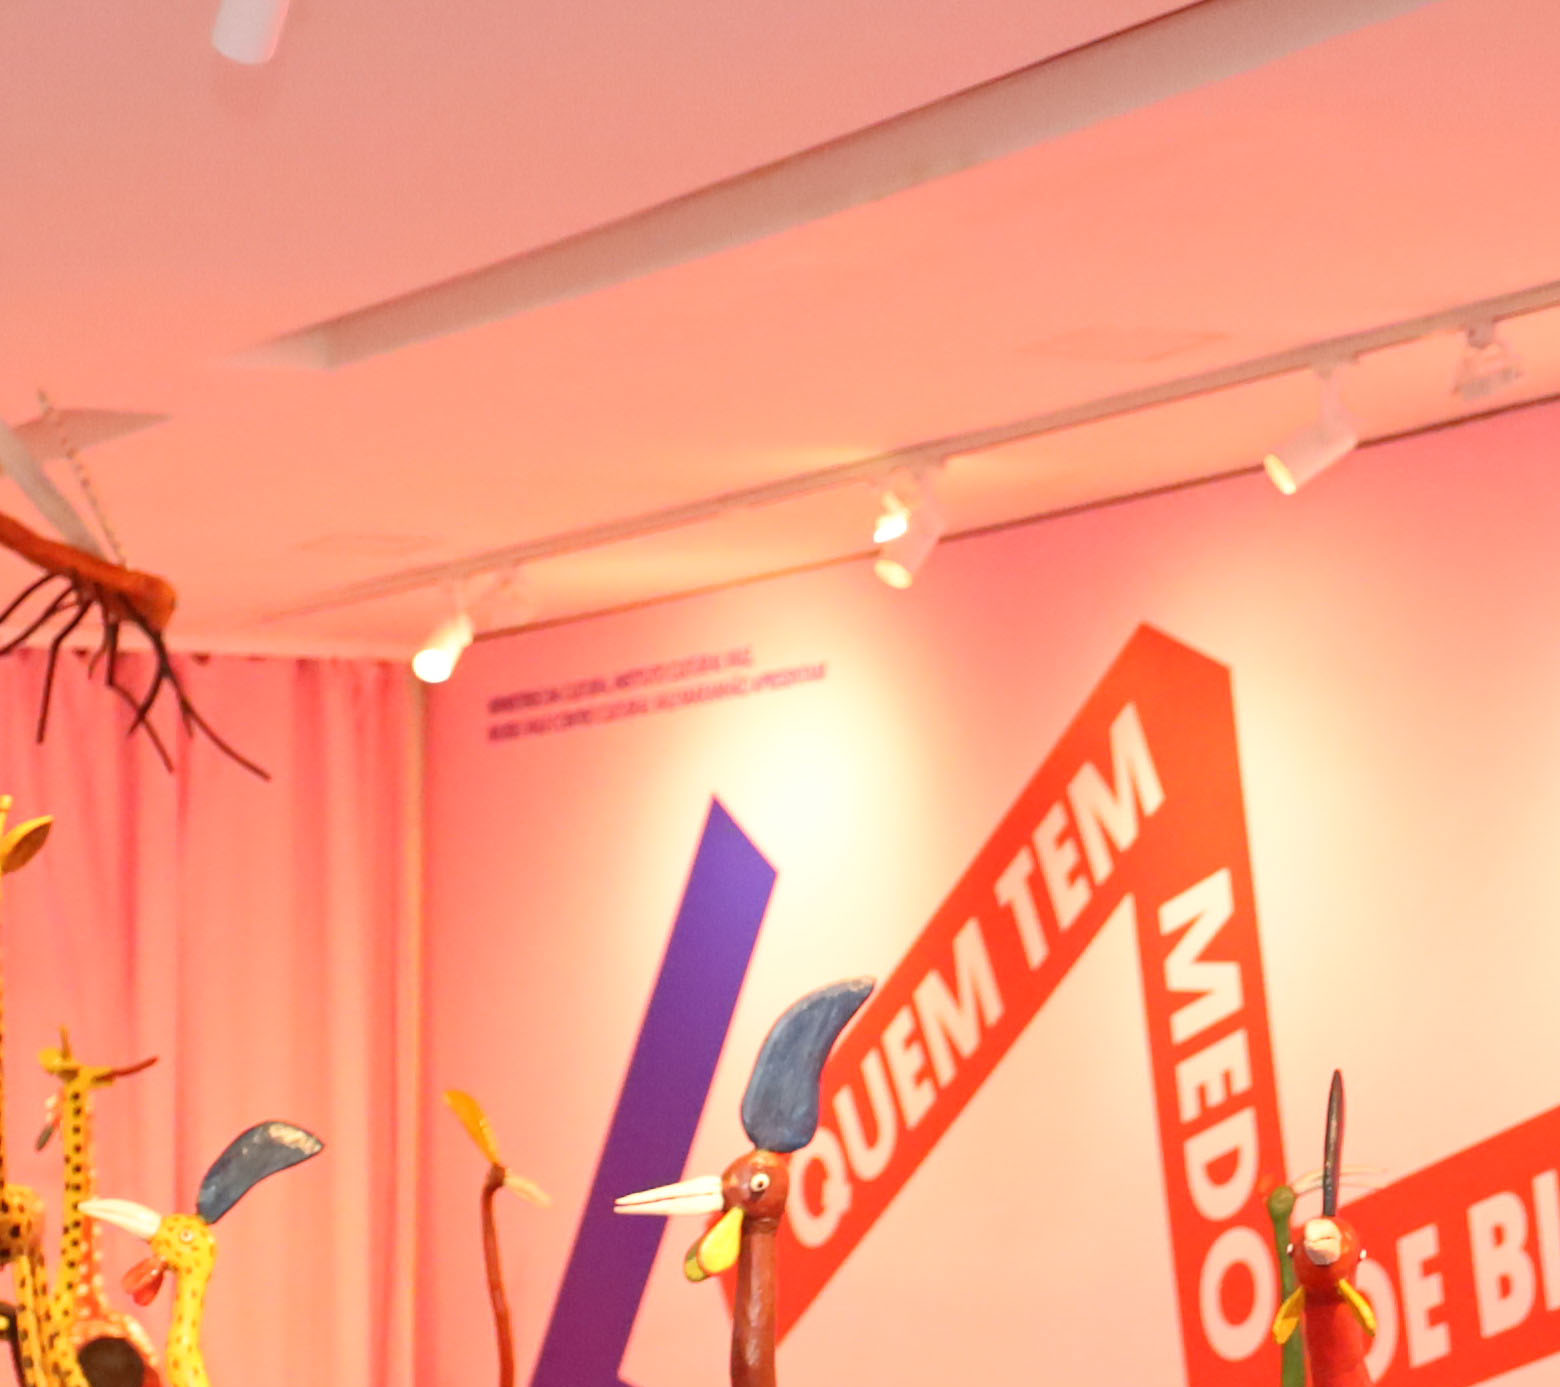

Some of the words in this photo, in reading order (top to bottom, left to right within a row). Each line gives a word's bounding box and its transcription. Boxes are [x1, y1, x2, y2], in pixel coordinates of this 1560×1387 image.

[787, 916, 1005, 1248] QUEM
[992, 700, 1167, 972] TEM
[1156, 866, 1278, 1363] MEDO
